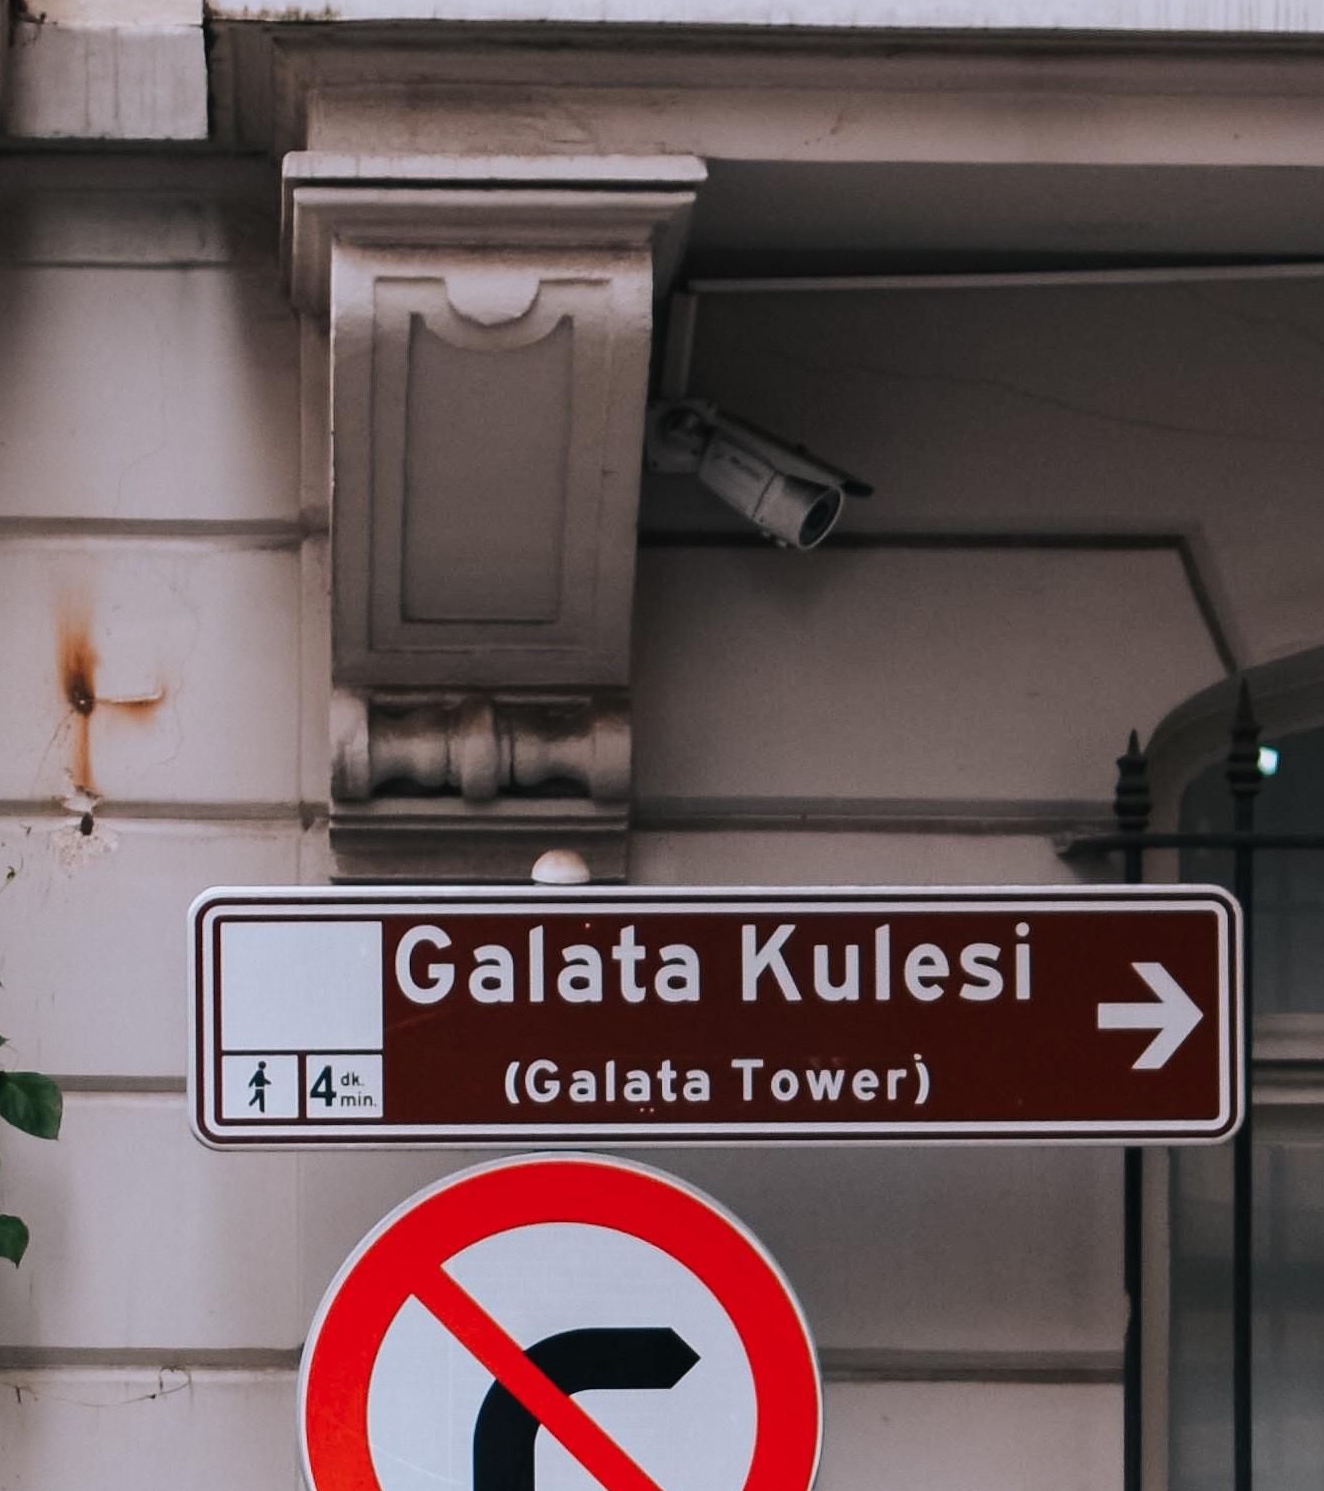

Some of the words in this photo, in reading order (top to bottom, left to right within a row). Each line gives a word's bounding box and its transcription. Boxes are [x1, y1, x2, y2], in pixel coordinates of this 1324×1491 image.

[395, 923, 700, 1004] Galata
[741, 922, 1031, 1002] Kulesi
[309, 1065, 337, 1107] 4
[504, 1059, 710, 1105] (Galata
[731, 1054, 930, 1105] Tower)
